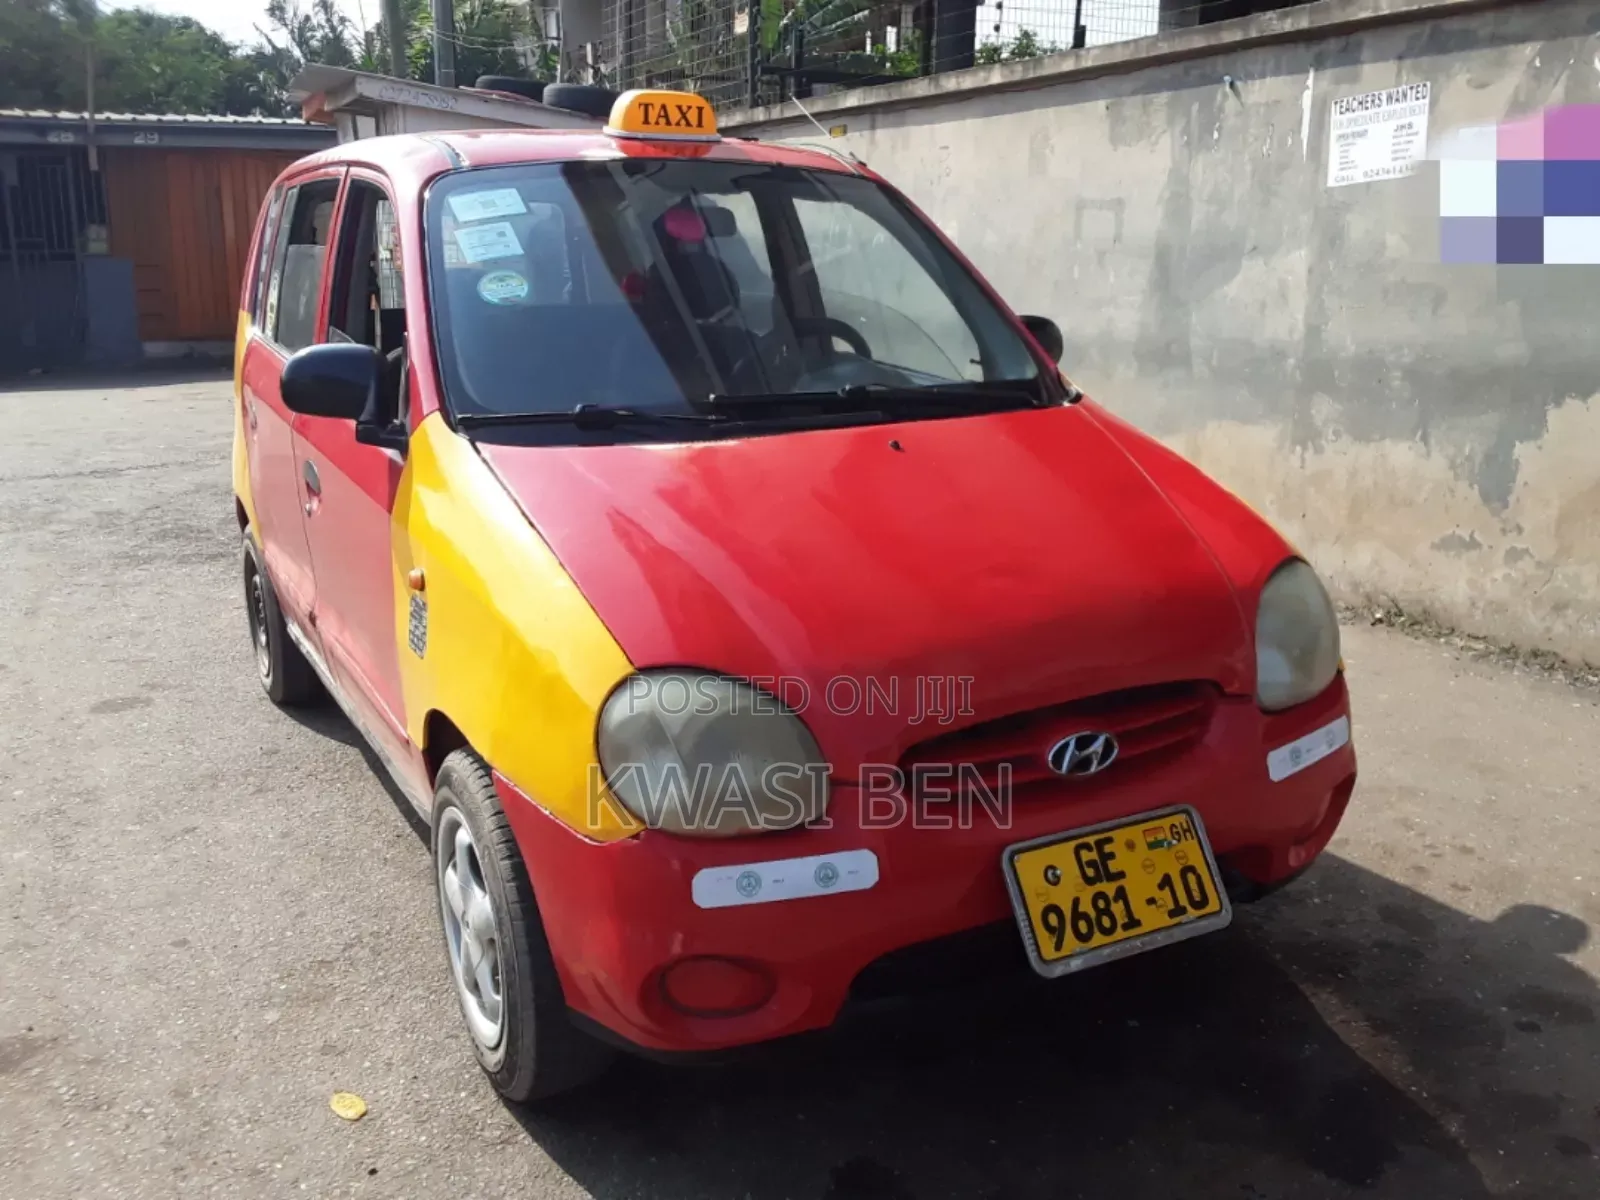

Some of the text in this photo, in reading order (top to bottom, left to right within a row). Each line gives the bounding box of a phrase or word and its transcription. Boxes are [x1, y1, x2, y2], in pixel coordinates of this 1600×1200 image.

[1333, 83, 1428, 116] TEACHERS WANTED
[638, 102, 705, 128] TAXI
[133, 131, 160, 144] 29
[1169, 820, 1194, 844] GH
[1073, 836, 1126, 886] GE
